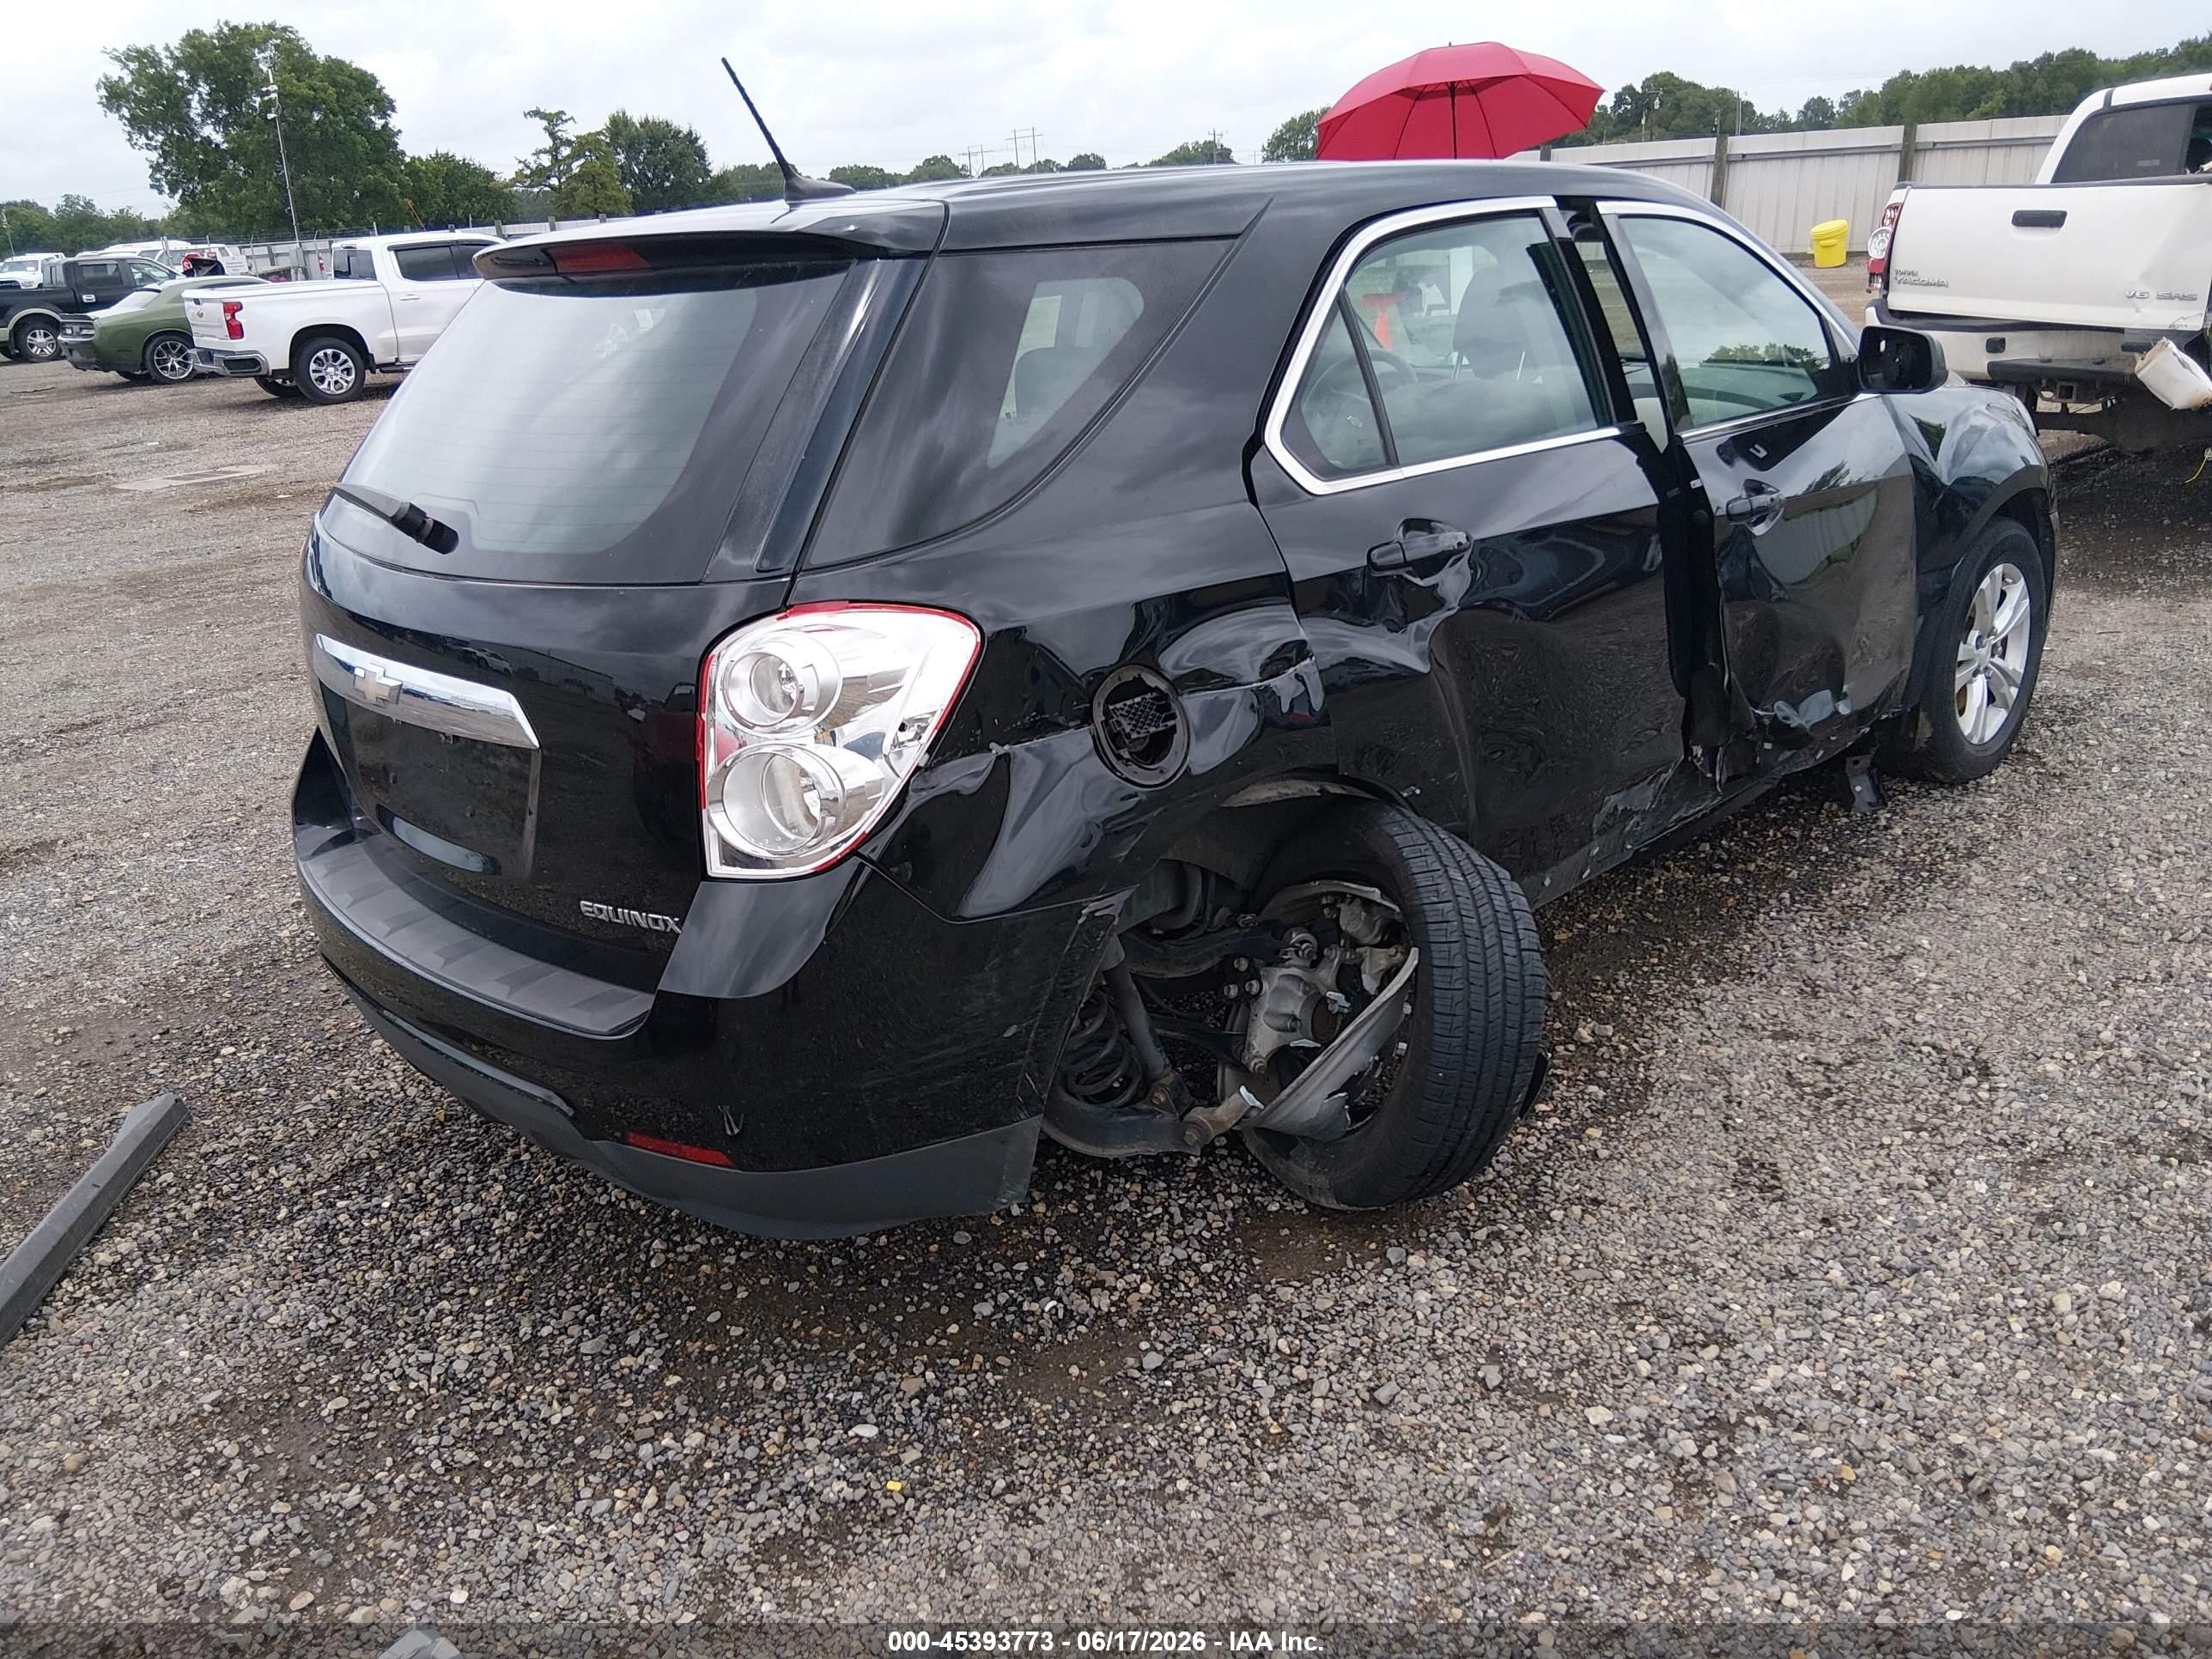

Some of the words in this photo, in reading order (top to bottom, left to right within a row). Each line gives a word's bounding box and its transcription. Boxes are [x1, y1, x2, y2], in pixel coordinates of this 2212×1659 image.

[1894, 276, 1949, 288] TACOMA
[2124, 289, 2150, 299] V6
[580, 900, 682, 933] EQUINOX
